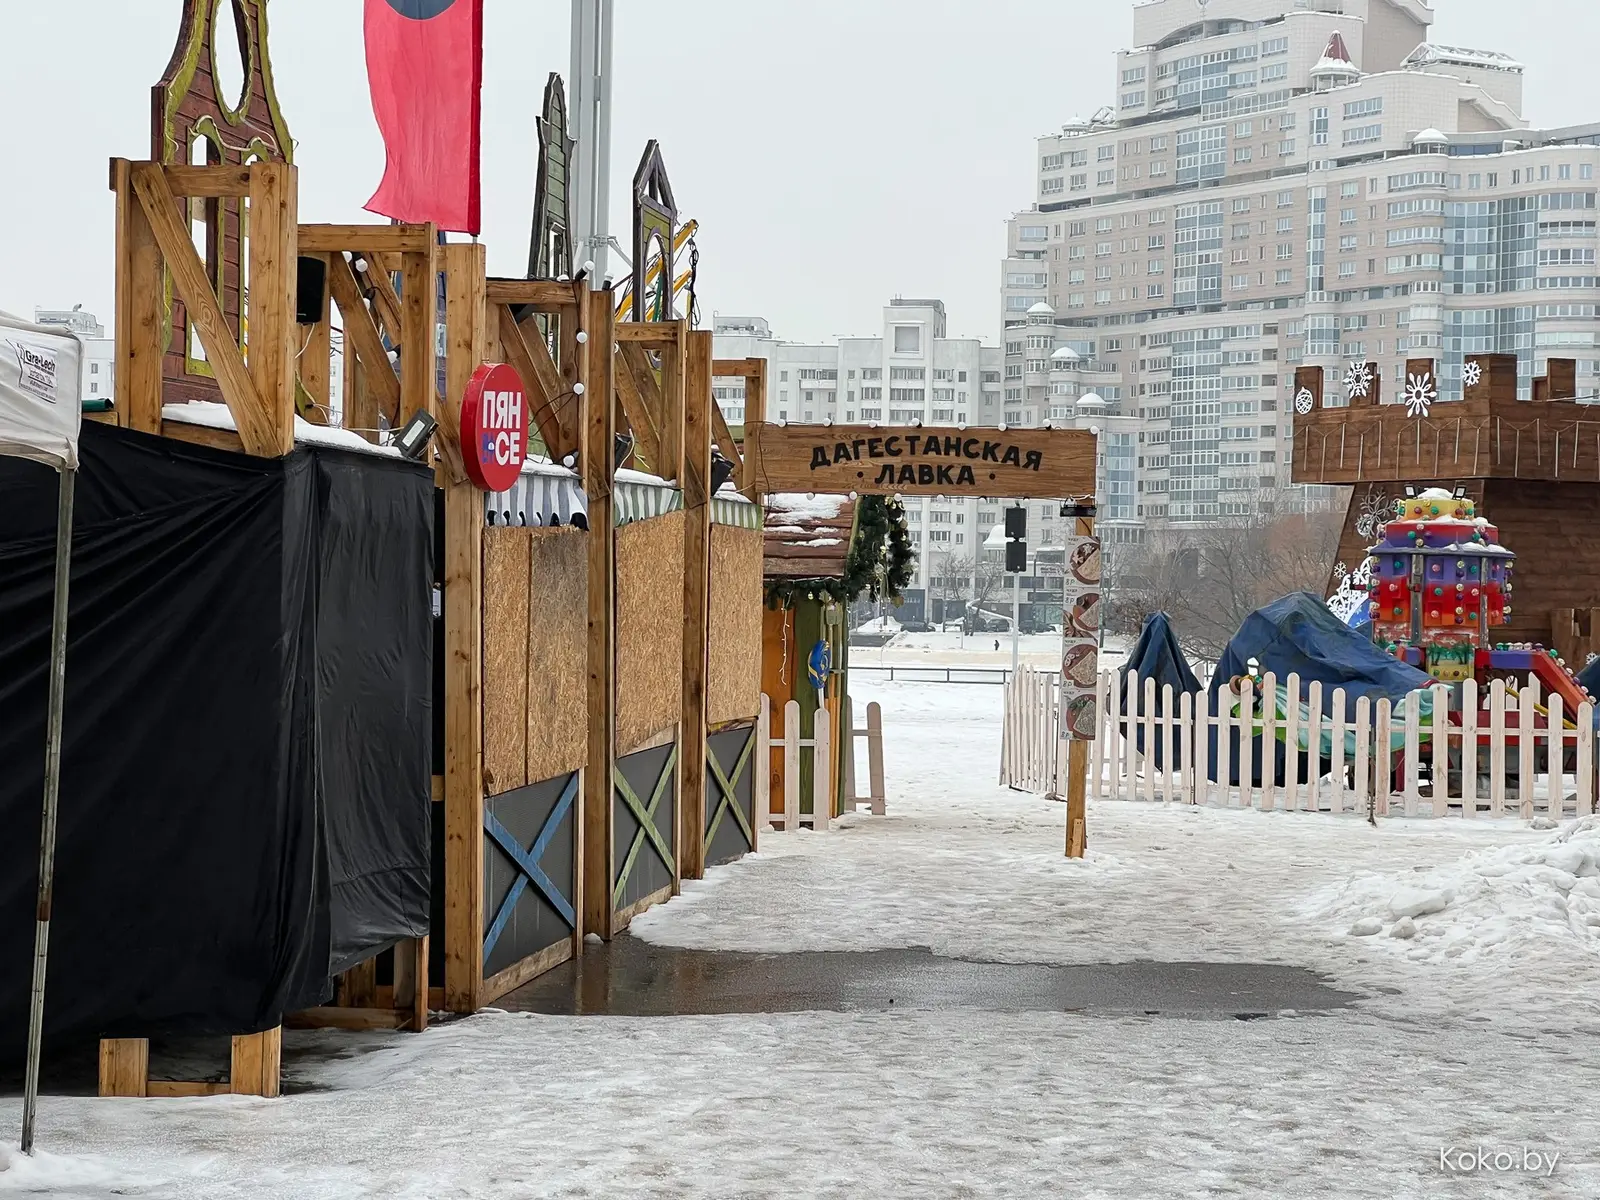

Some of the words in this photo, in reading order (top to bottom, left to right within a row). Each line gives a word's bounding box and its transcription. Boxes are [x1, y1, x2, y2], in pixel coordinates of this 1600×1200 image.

[482, 391, 521, 429] ПЯН
[495, 431, 520, 466] СЕ
[810, 435, 1043, 471] ДАГЕСТАНСКАЯ
[874, 464, 976, 486] ЛАВКА
